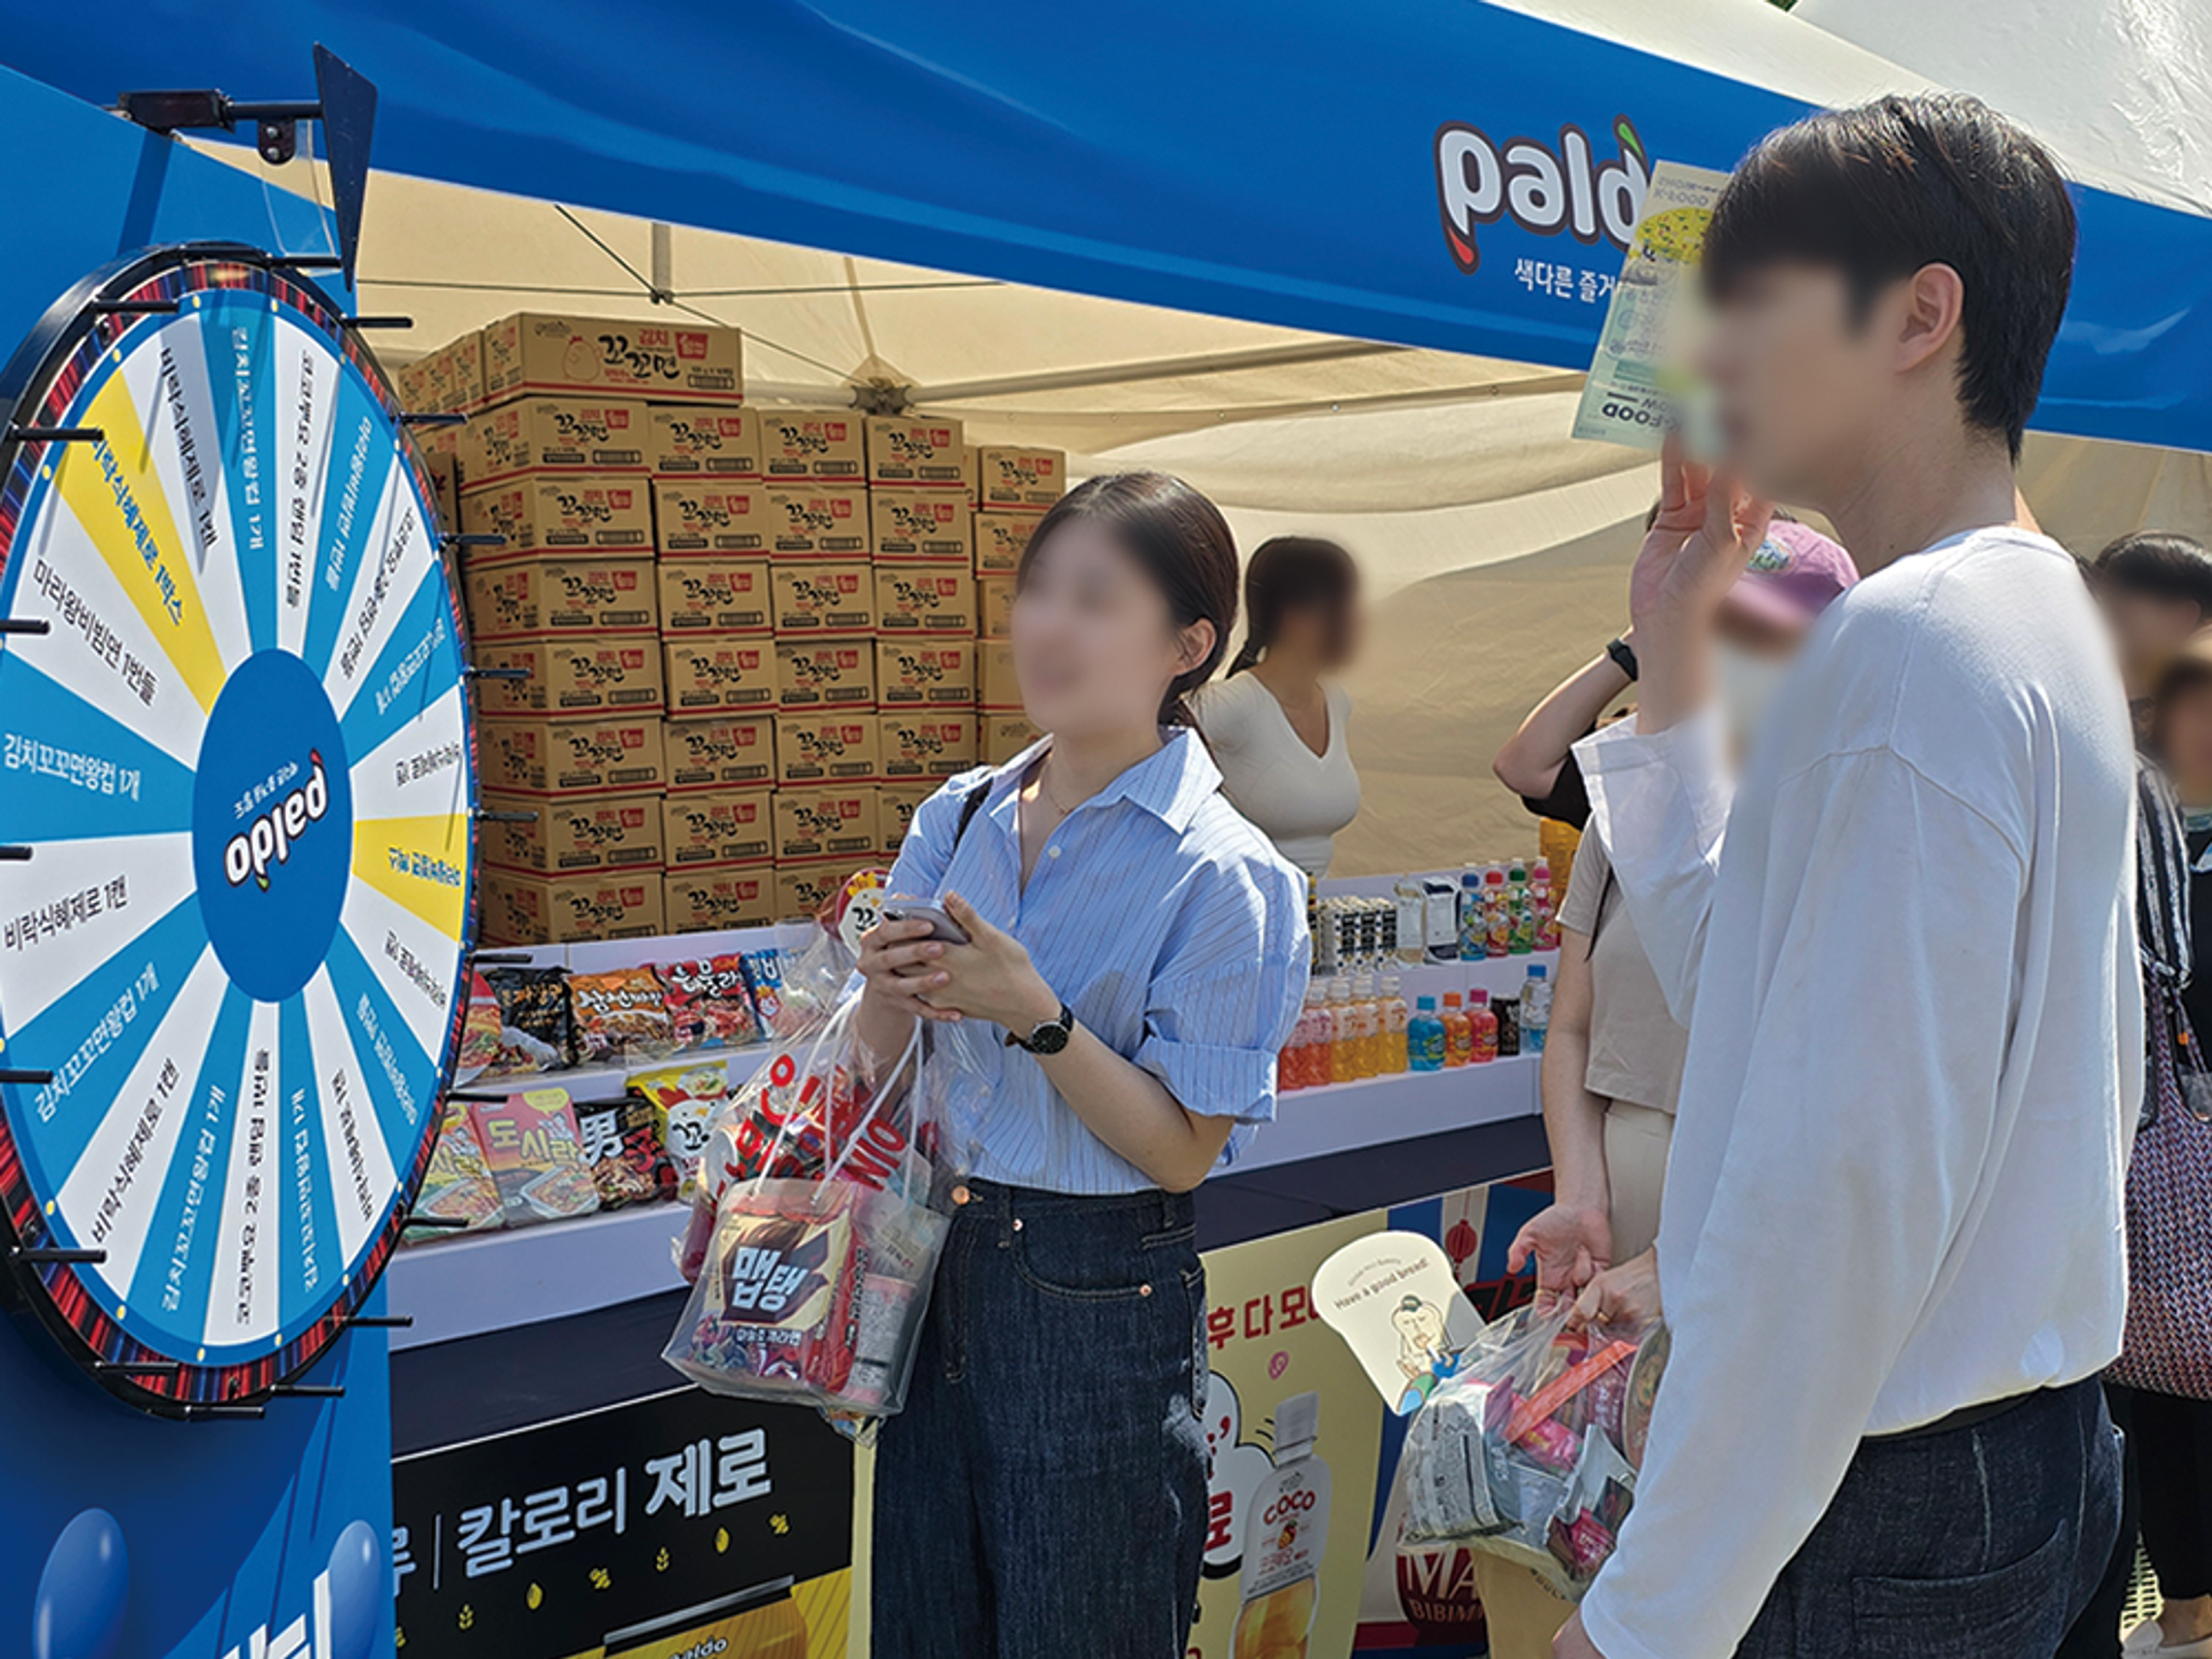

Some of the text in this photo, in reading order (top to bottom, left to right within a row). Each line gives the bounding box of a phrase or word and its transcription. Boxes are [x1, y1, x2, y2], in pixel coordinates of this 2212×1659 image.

[1514, 257, 1572, 299] 색다른
[597, 334, 680, 380] 꼬꼬면
[554, 412, 609, 444] 꼬꼬면
[556, 495, 612, 524] 꼬꼬면
[249, 514, 264, 549] 1개
[154, 563, 185, 627] 1박스
[560, 576, 617, 606] 꼬꼬면
[33, 559, 157, 706] 마라왕비빔면 1번들
[570, 657, 624, 684] 꼬꼬면
[3, 733, 141, 802] 김치꼬꼬면왕컵 1개
[569, 738, 624, 765] 꼬꼬면
[224, 747, 329, 893] paldo
[569, 817, 624, 843] 꼬꼬면
[3, 874, 128, 952] 비락식혜제로 1캔
[570, 897, 624, 924] 꼬꼬면
[35, 961, 160, 1123] 김치꼬꼬면왕컵 1개
[206, 1084, 226, 1123] 1개
[487, 1119, 582, 1172] 도시락
[732, 1247, 808, 1312] 맵탱
[457, 1467, 626, 1578] 칼로리
[643, 1428, 772, 1517] 제로
[1263, 1489, 1316, 1526] COCO
